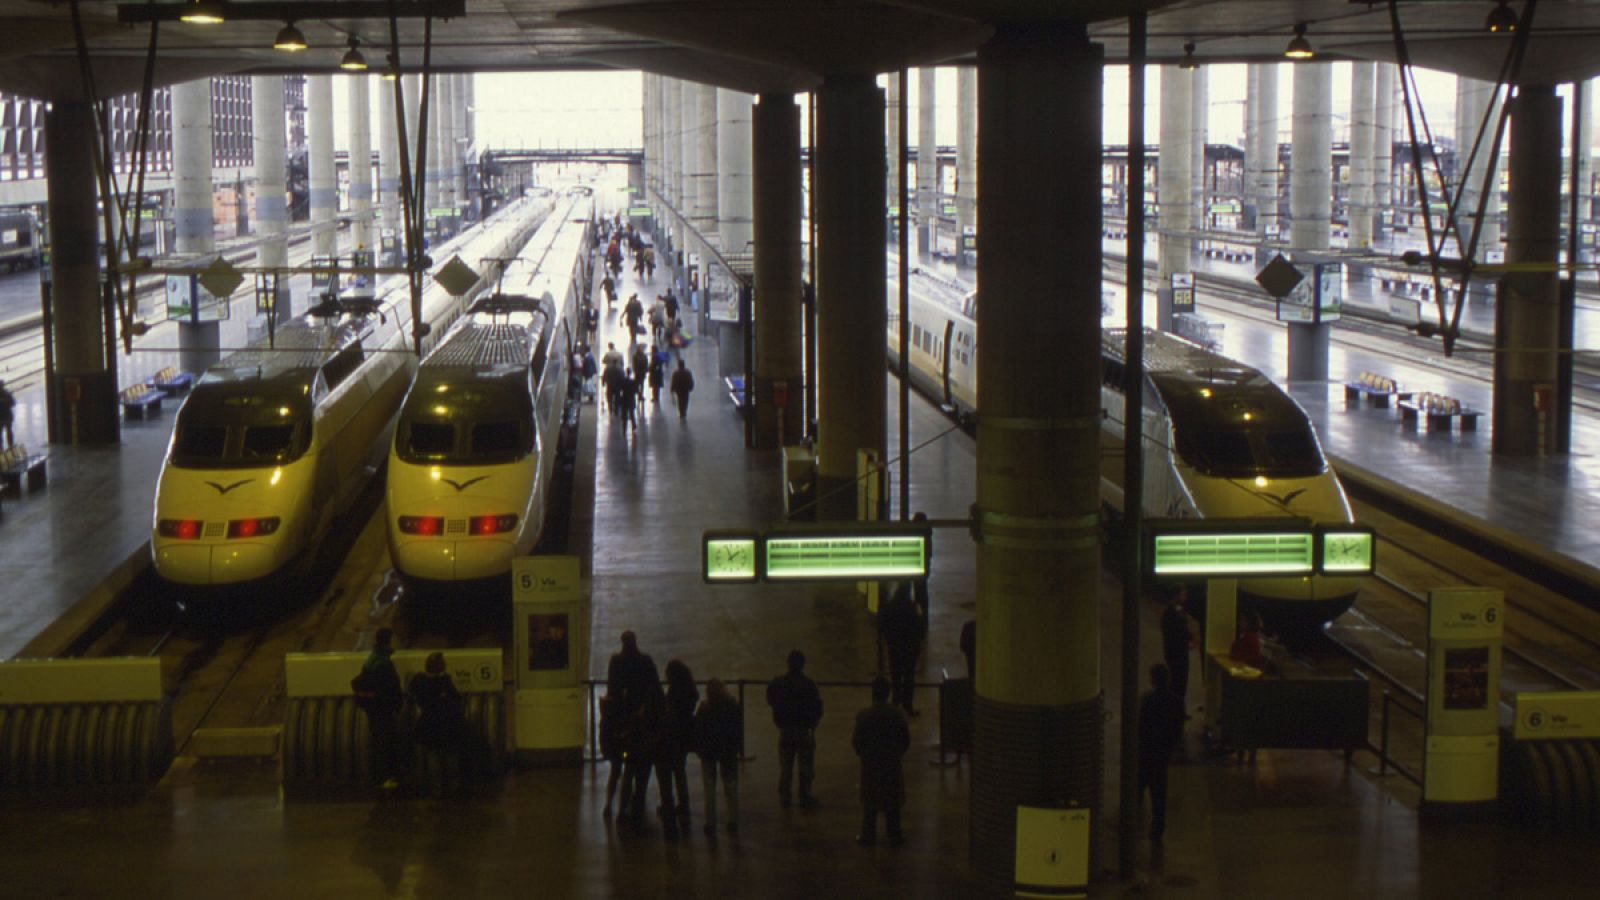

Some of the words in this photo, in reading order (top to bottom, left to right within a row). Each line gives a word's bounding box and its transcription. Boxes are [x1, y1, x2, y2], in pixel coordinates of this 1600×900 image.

[521, 575, 531, 588] 5
[1486, 607, 1496, 622] 6
[480, 667, 490, 681] 5
[1529, 712, 1541, 727] 6
